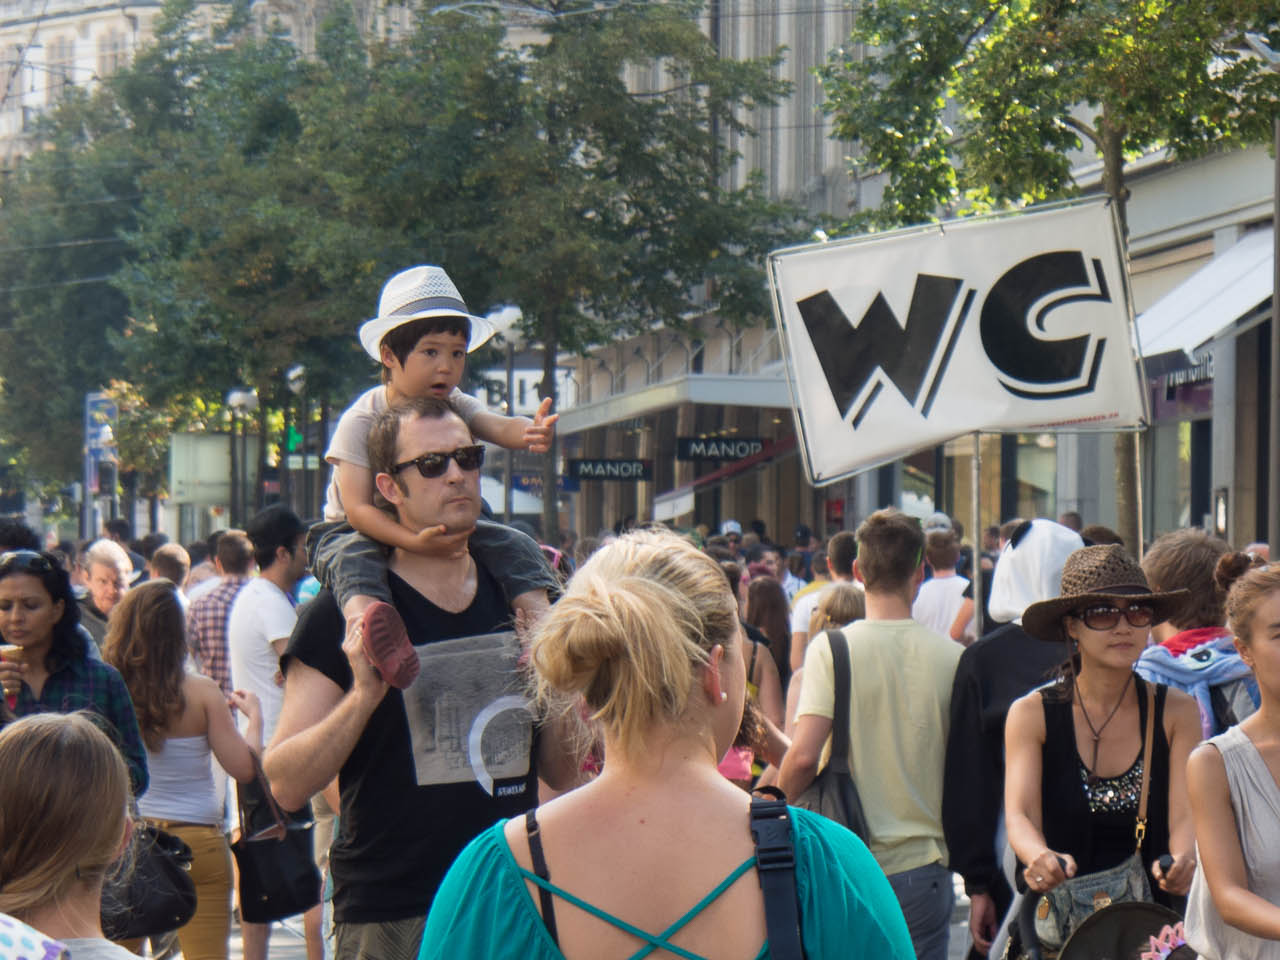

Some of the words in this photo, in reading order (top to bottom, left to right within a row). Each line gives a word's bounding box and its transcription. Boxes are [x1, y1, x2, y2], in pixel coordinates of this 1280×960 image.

[796, 250, 1113, 431] WC
[691, 441, 762, 458] MANOR
[579, 462, 644, 477] MANOR
